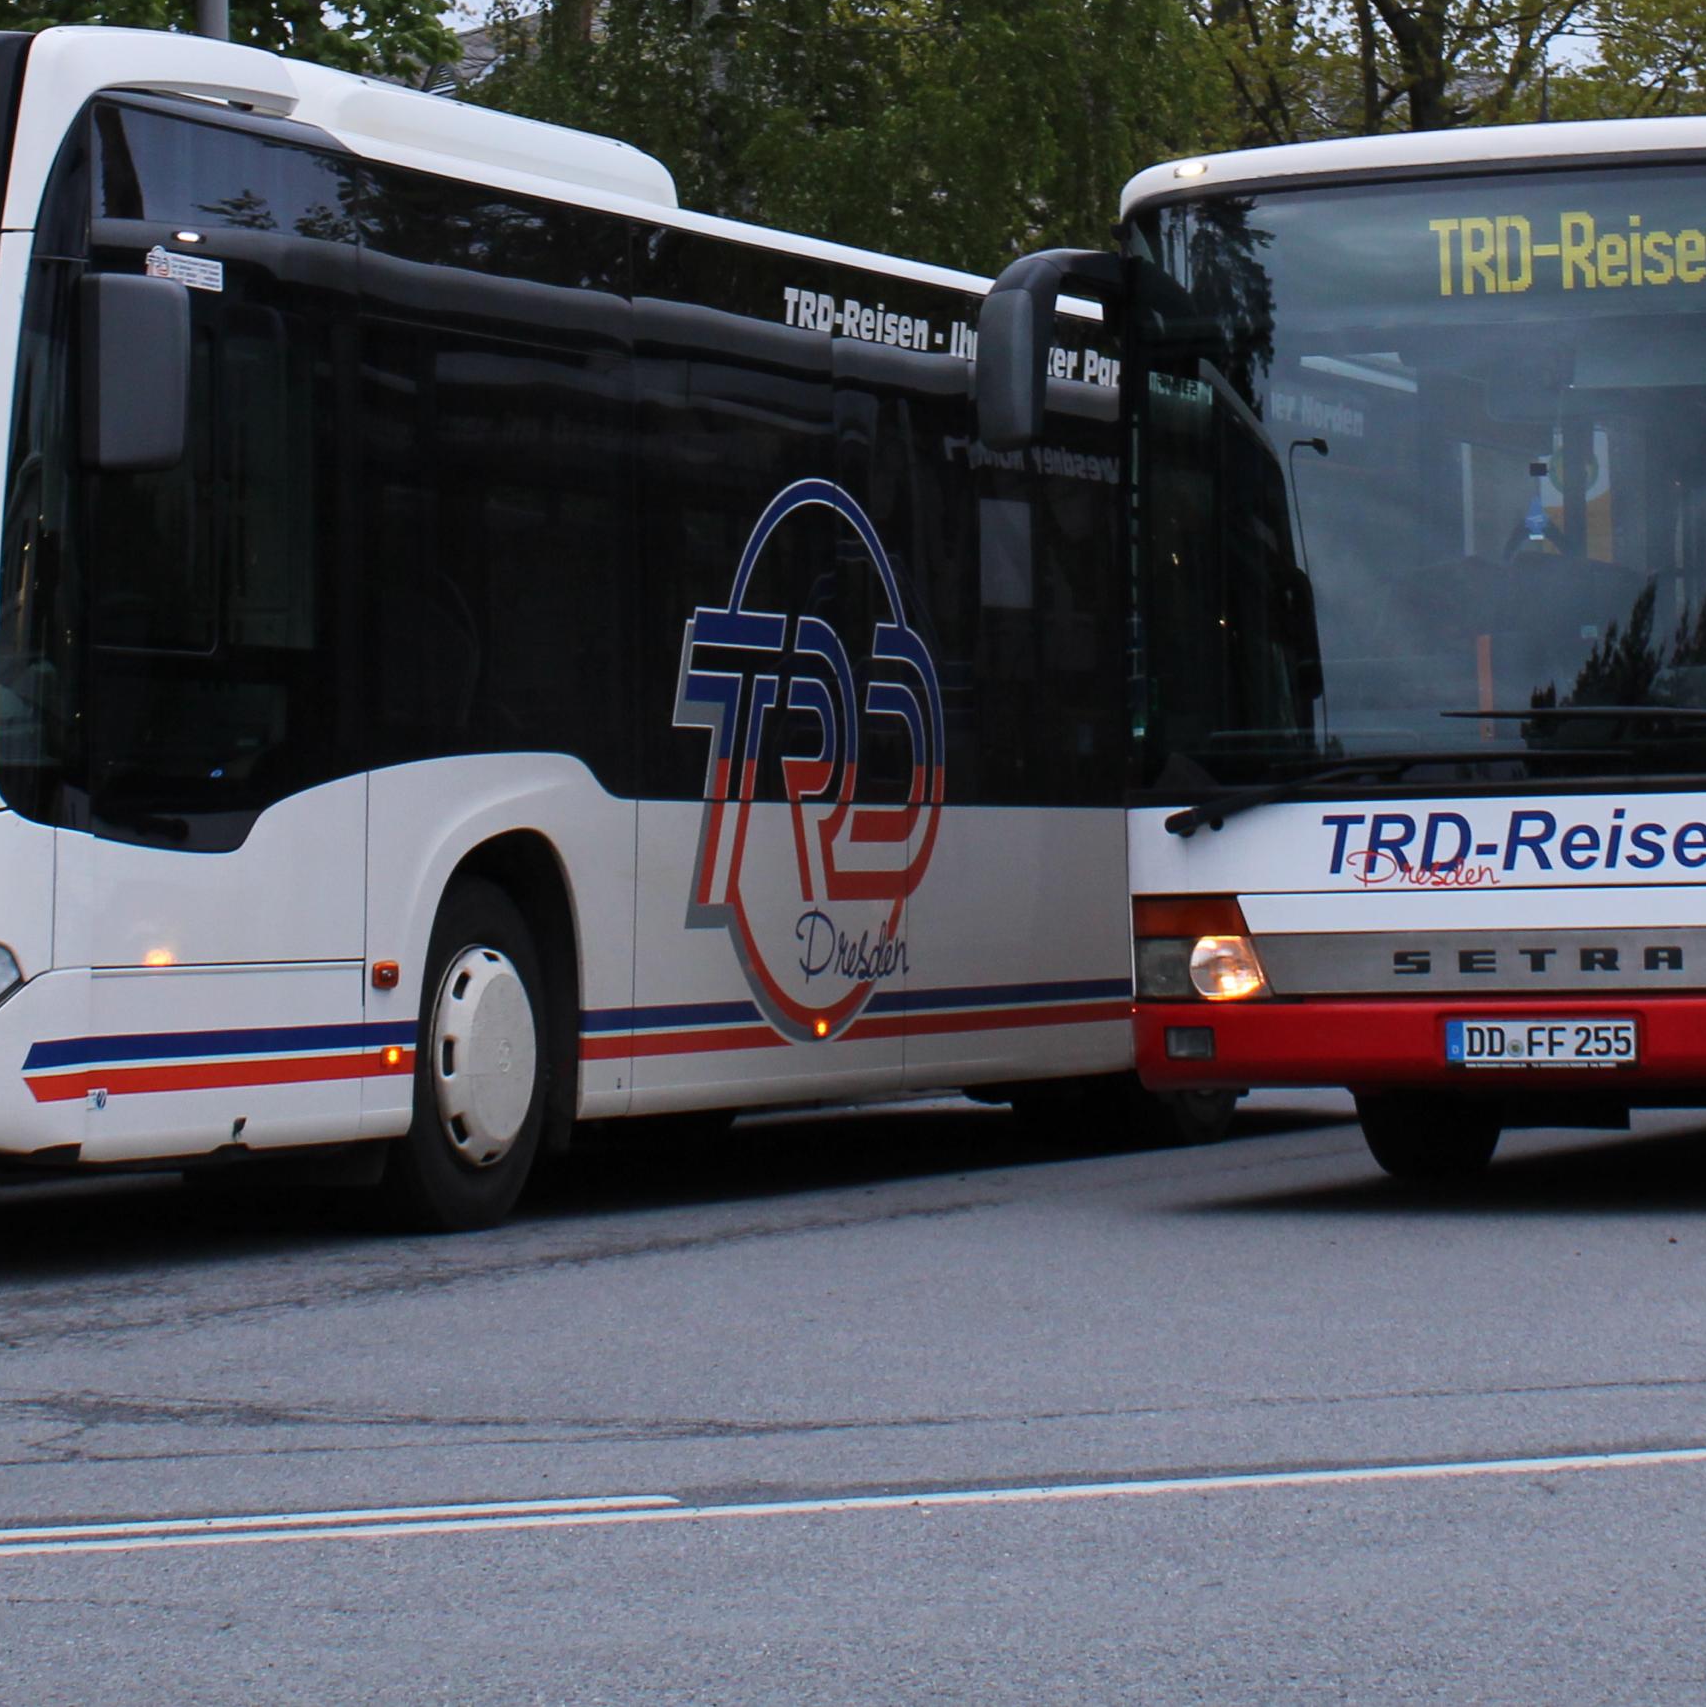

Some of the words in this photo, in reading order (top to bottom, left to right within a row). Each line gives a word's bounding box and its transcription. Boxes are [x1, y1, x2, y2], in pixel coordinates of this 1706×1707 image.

[783, 286, 930, 351] TRD-Reisen
[673, 606, 946, 906] TRD
[1346, 850, 1500, 888] Dresden
[796, 906, 910, 984] Dresden
[1393, 946, 1684, 975] SETRA
[1465, 1026, 1505, 1057] DD
[1526, 1026, 1567, 1057] FF
[1574, 1026, 1632, 1057] 255
